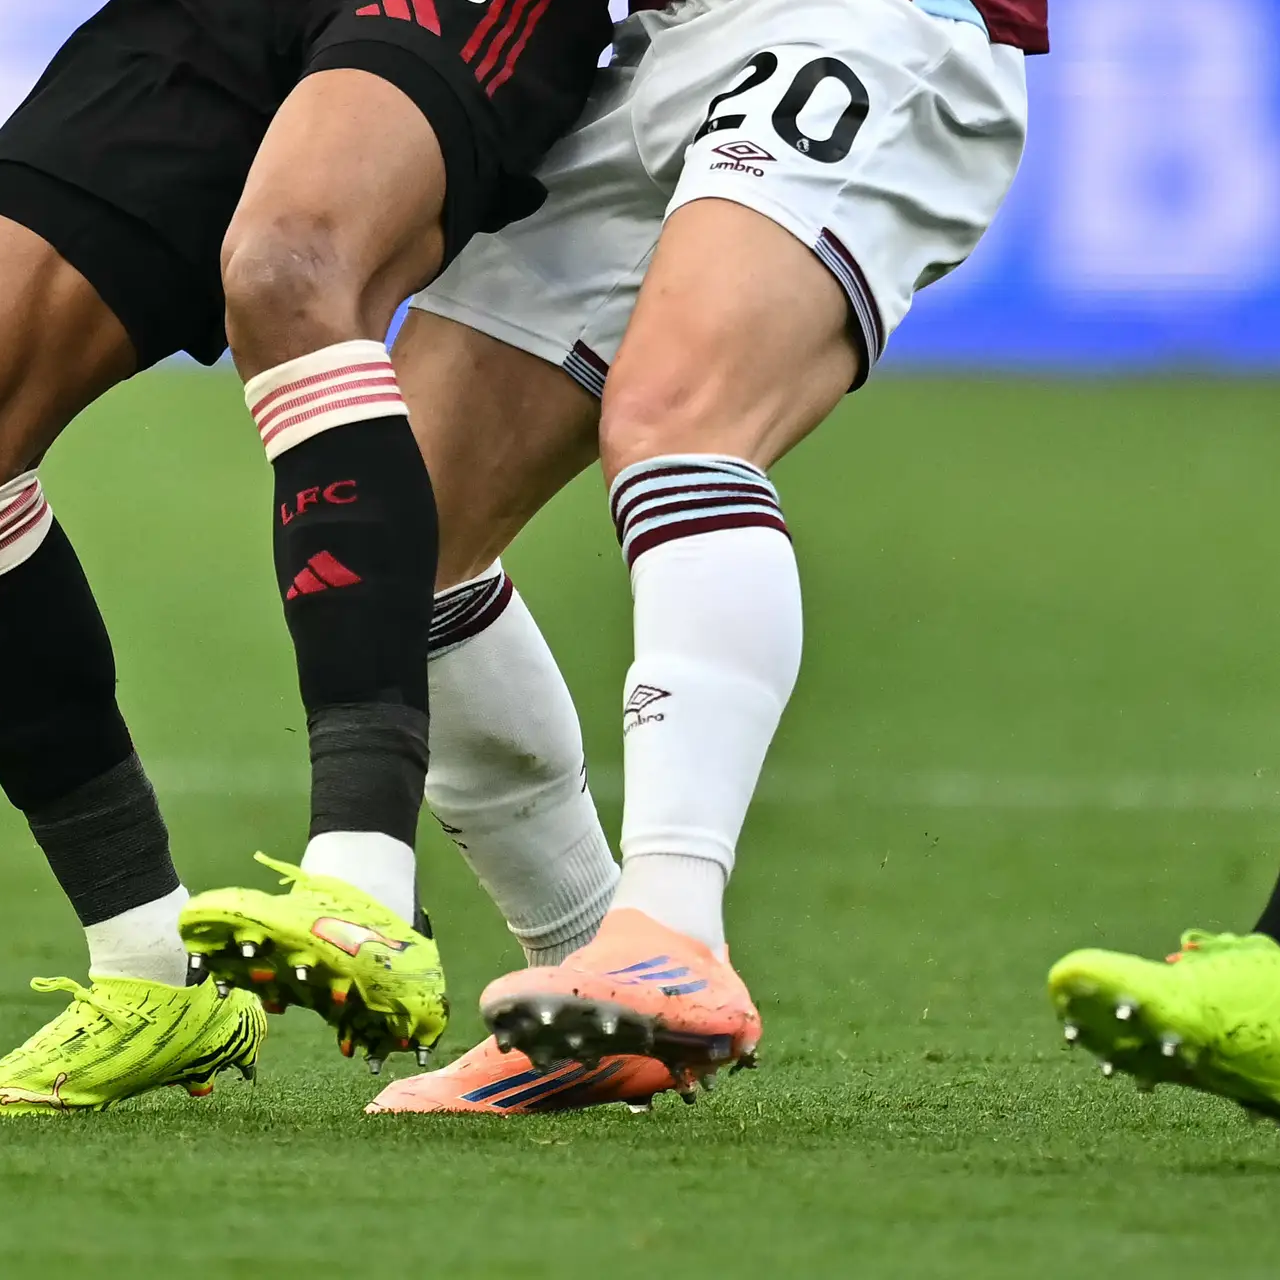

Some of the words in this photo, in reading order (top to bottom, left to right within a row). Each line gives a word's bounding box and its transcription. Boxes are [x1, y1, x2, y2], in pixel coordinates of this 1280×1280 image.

[693, 51, 870, 164] 20
[709, 158, 765, 178] umbro
[280, 479, 358, 526] LFC
